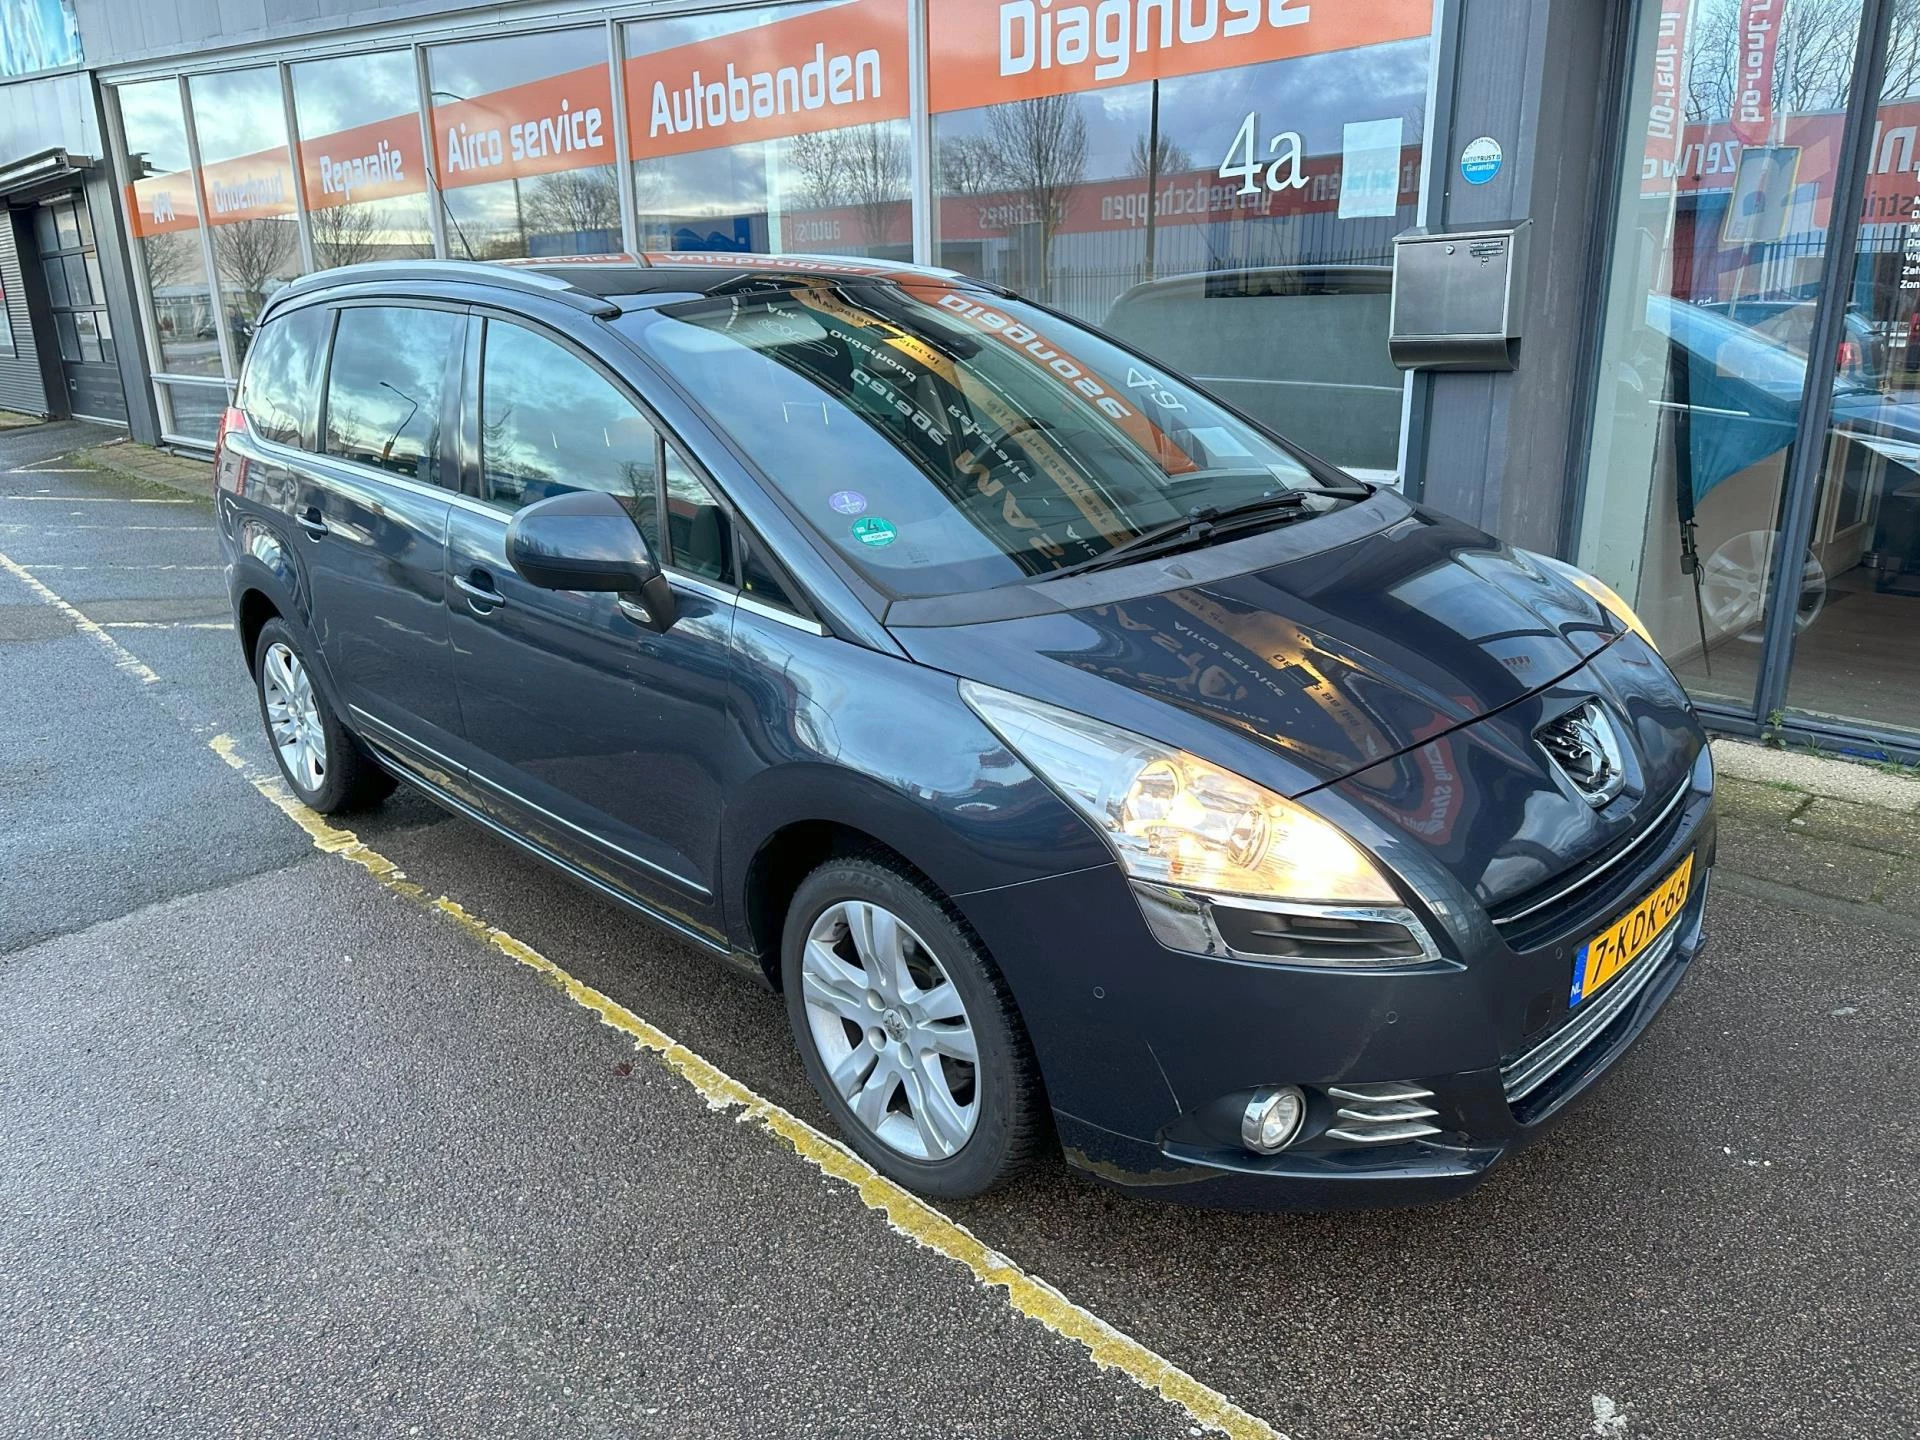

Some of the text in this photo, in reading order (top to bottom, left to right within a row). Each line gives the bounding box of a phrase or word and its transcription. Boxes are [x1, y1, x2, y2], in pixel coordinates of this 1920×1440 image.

[1000, 0, 1310, 80] Diagnose
[649, 42, 881, 138] Autobanden
[319, 139, 404, 201] Reparatie
[448, 99, 604, 173] Airco service
[1218, 111, 1310, 196] 4a
[1462, 154, 1496, 163] AUTOTRUST
[1591, 866, 1687, 985] 7-KDK-66
[1570, 984, 1582, 998] NL
